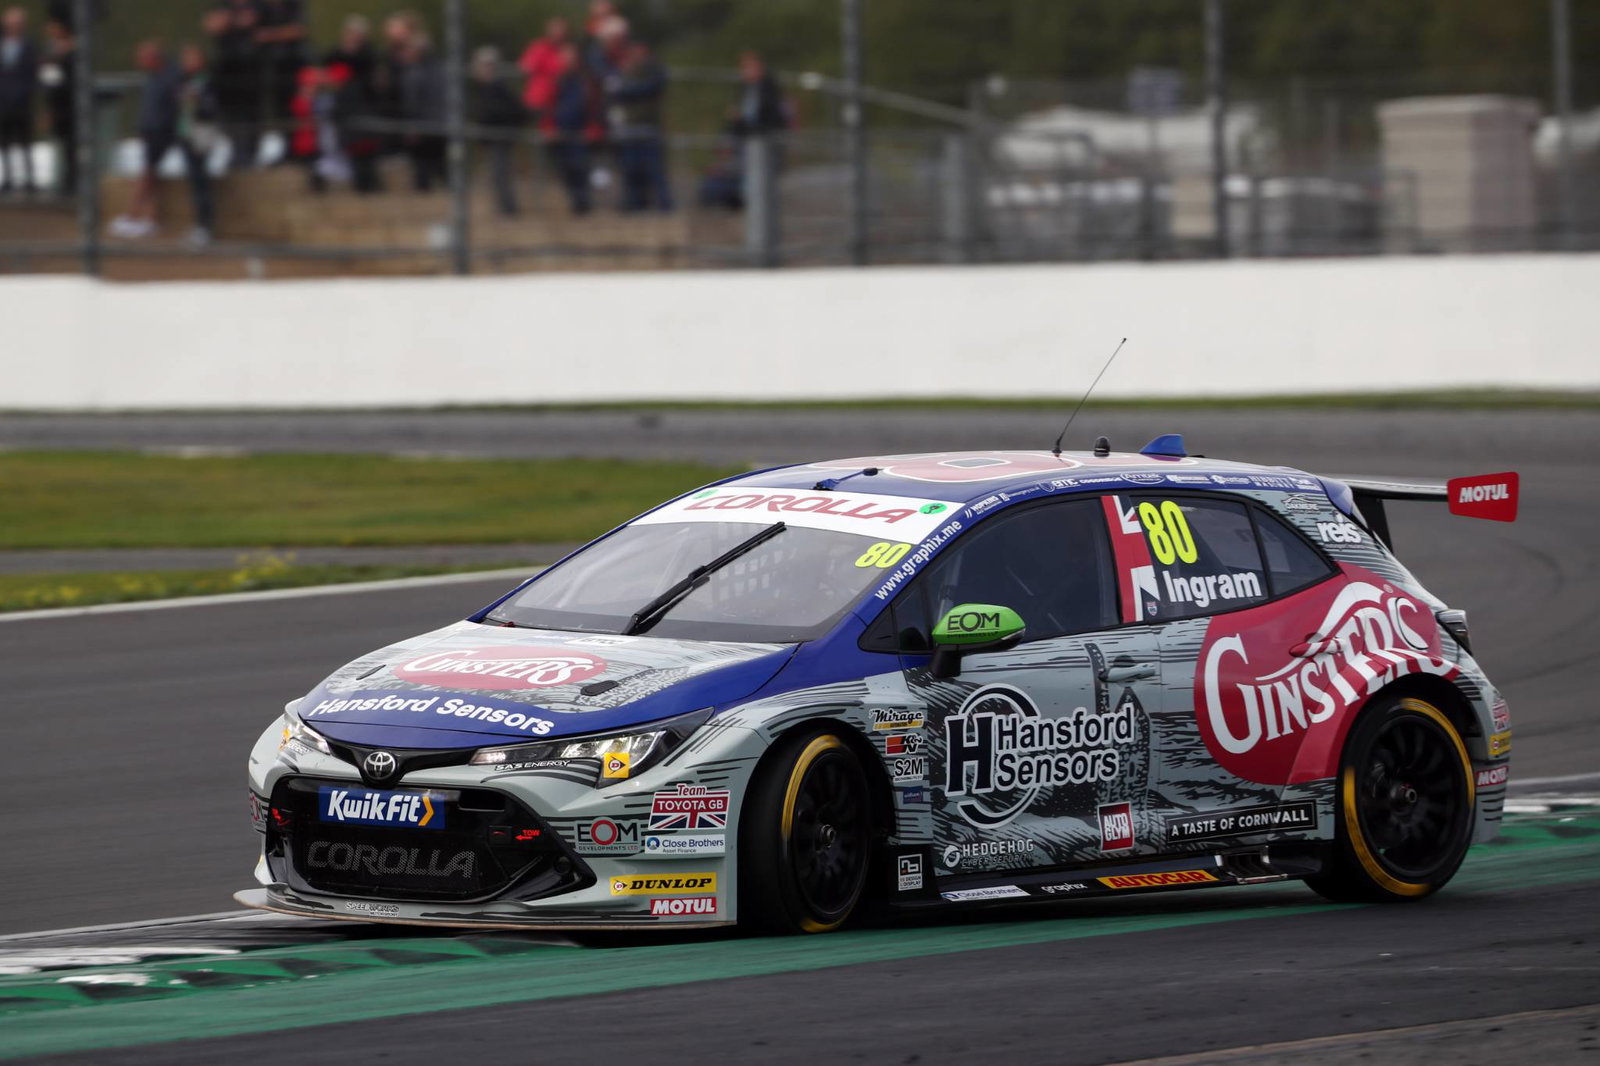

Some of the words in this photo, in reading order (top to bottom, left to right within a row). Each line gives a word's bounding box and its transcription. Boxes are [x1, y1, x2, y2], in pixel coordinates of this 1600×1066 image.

[1459, 483, 1509, 503] MOTUL
[683, 494, 919, 524] COROLLA
[1138, 500, 1198, 566] 80
[1316, 513, 1361, 543] reis
[854, 542, 912, 568] 80
[874, 520, 962, 600] www.graphix.me
[1163, 571, 1262, 608] Ingram
[947, 611, 1000, 632] EOM
[308, 694, 440, 717] Hansford
[436, 698, 555, 736] Sensors
[874, 709, 923, 724] Mirage
[998, 705, 1133, 750] Hansford
[524, 760, 571, 769] ENERGY
[894, 758, 922, 777] S2M
[997, 751, 1118, 789] Sensors
[677, 784, 707, 796] Team
[657, 801, 706, 811] TOYOTA
[708, 800, 724, 810] GB
[523, 829, 540, 837] TOW
[578, 819, 638, 846] EOM
[1171, 825, 1179, 837] A
[1182, 819, 1216, 834] TASTE
[1220, 817, 1235, 829] OF
[1238, 809, 1309, 828] CORNWALL
[662, 840, 687, 848] Close
[688, 838, 724, 848] Brothers
[962, 839, 1034, 857] HEDGEHOG
[307, 840, 475, 878] COROLLA
[961, 857, 987, 868] CYBER
[629, 878, 712, 890] DUNLOP
[1109, 871, 1209, 888] AUTOCAR
[651, 899, 715, 915] MOTUL
